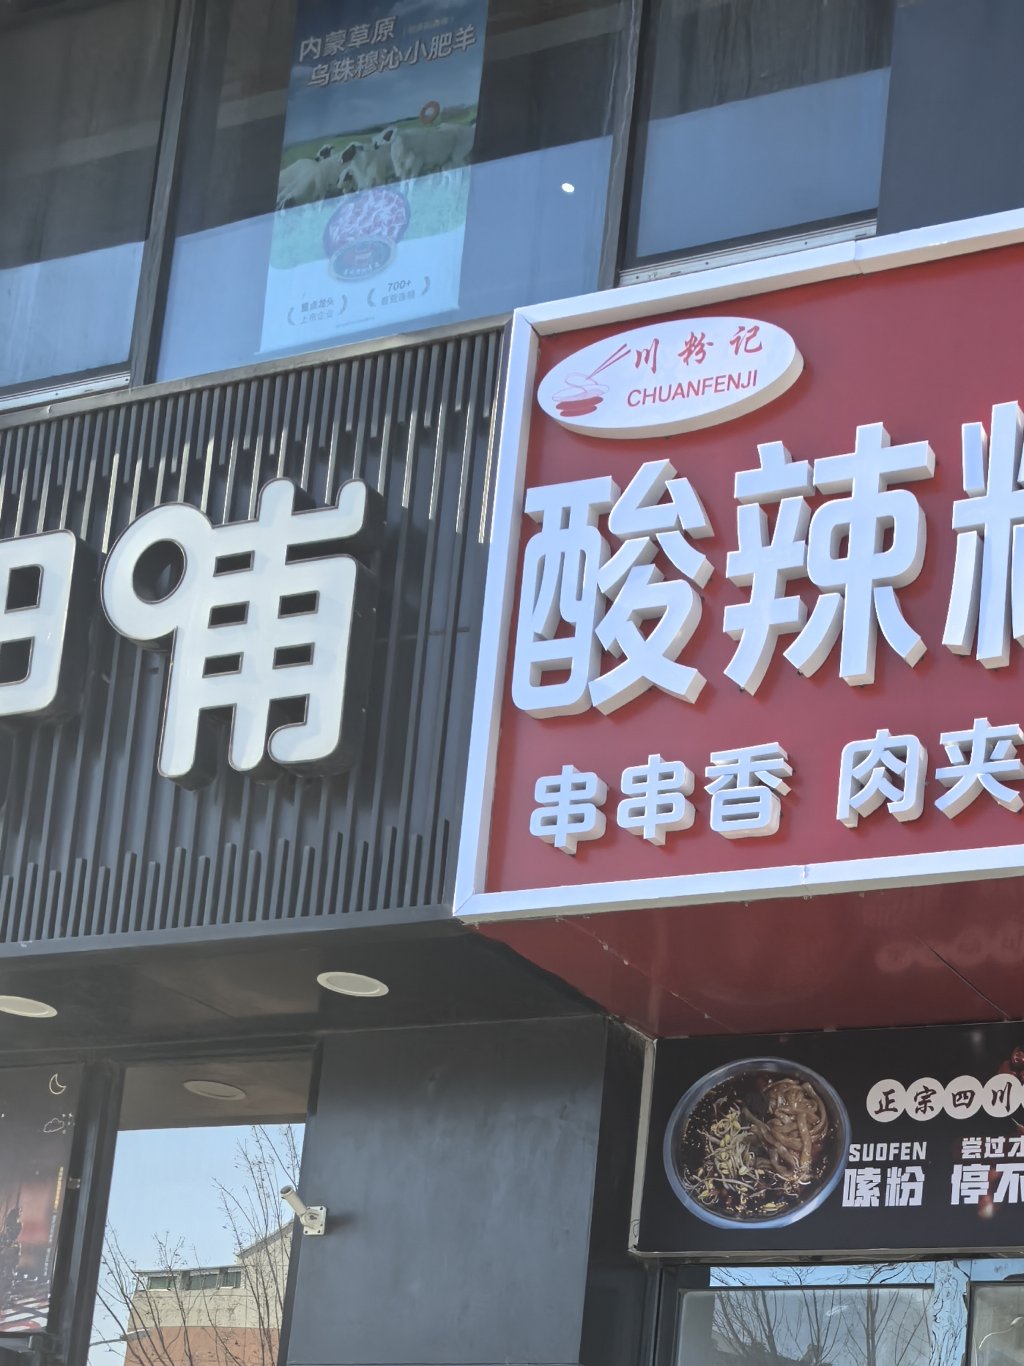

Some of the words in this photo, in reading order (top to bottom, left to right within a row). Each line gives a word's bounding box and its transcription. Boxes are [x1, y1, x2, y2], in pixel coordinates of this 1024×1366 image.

[299, 15, 397, 62] 内蒙草原
[307, 23, 477, 88] 乌珠穆沁小肥羊
[634, 325, 763, 375] 川粉记
[626, 369, 759, 408] CHUANFENJI
[529, 741, 793, 855] 串串香
[849, 1140, 928, 1163] SUOFEN
[841, 1165, 926, 1208] 嗦粉
